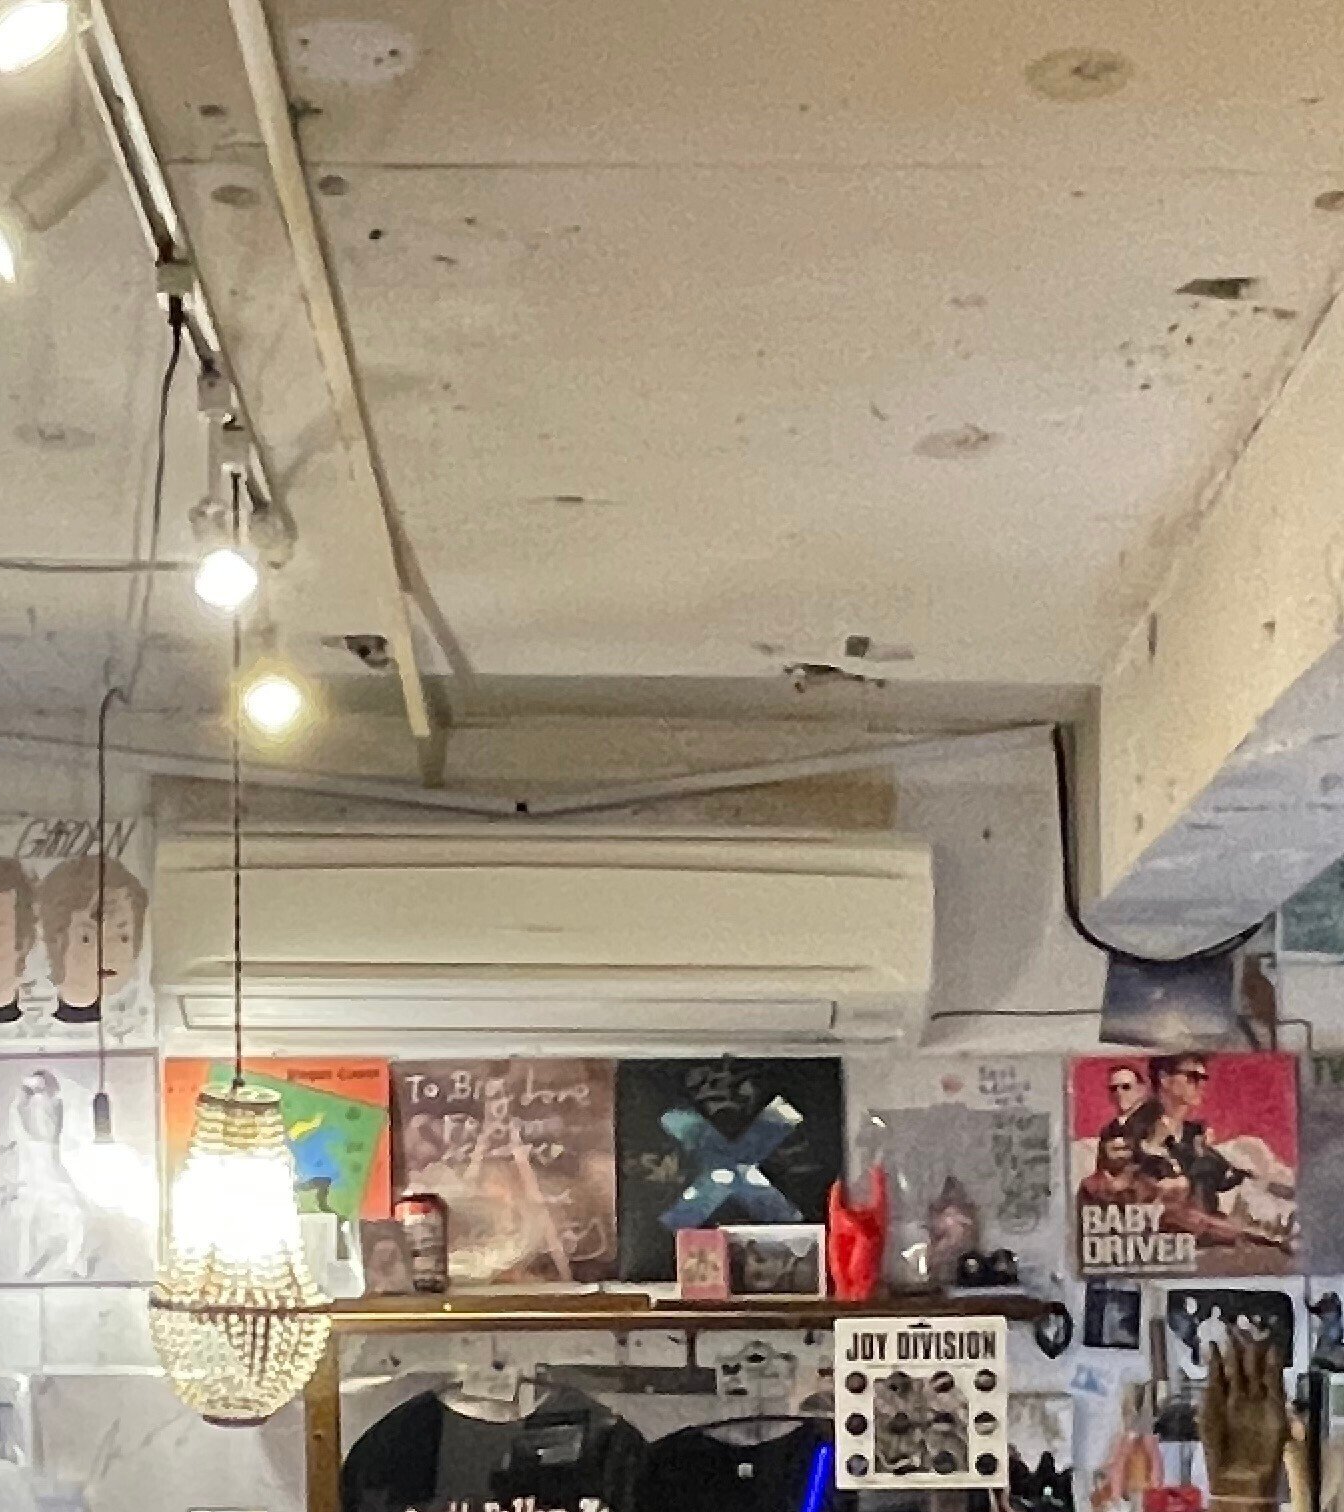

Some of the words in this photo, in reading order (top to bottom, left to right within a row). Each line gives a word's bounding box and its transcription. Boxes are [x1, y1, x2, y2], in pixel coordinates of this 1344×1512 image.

[15, 819, 138, 859] GARDEN
[1082, 1204, 1166, 1234] BABY
[1082, 1235, 1196, 1265] DRIVER
[845, 1332, 889, 1361] JOY
[896, 1331, 997, 1361] DIVISION
